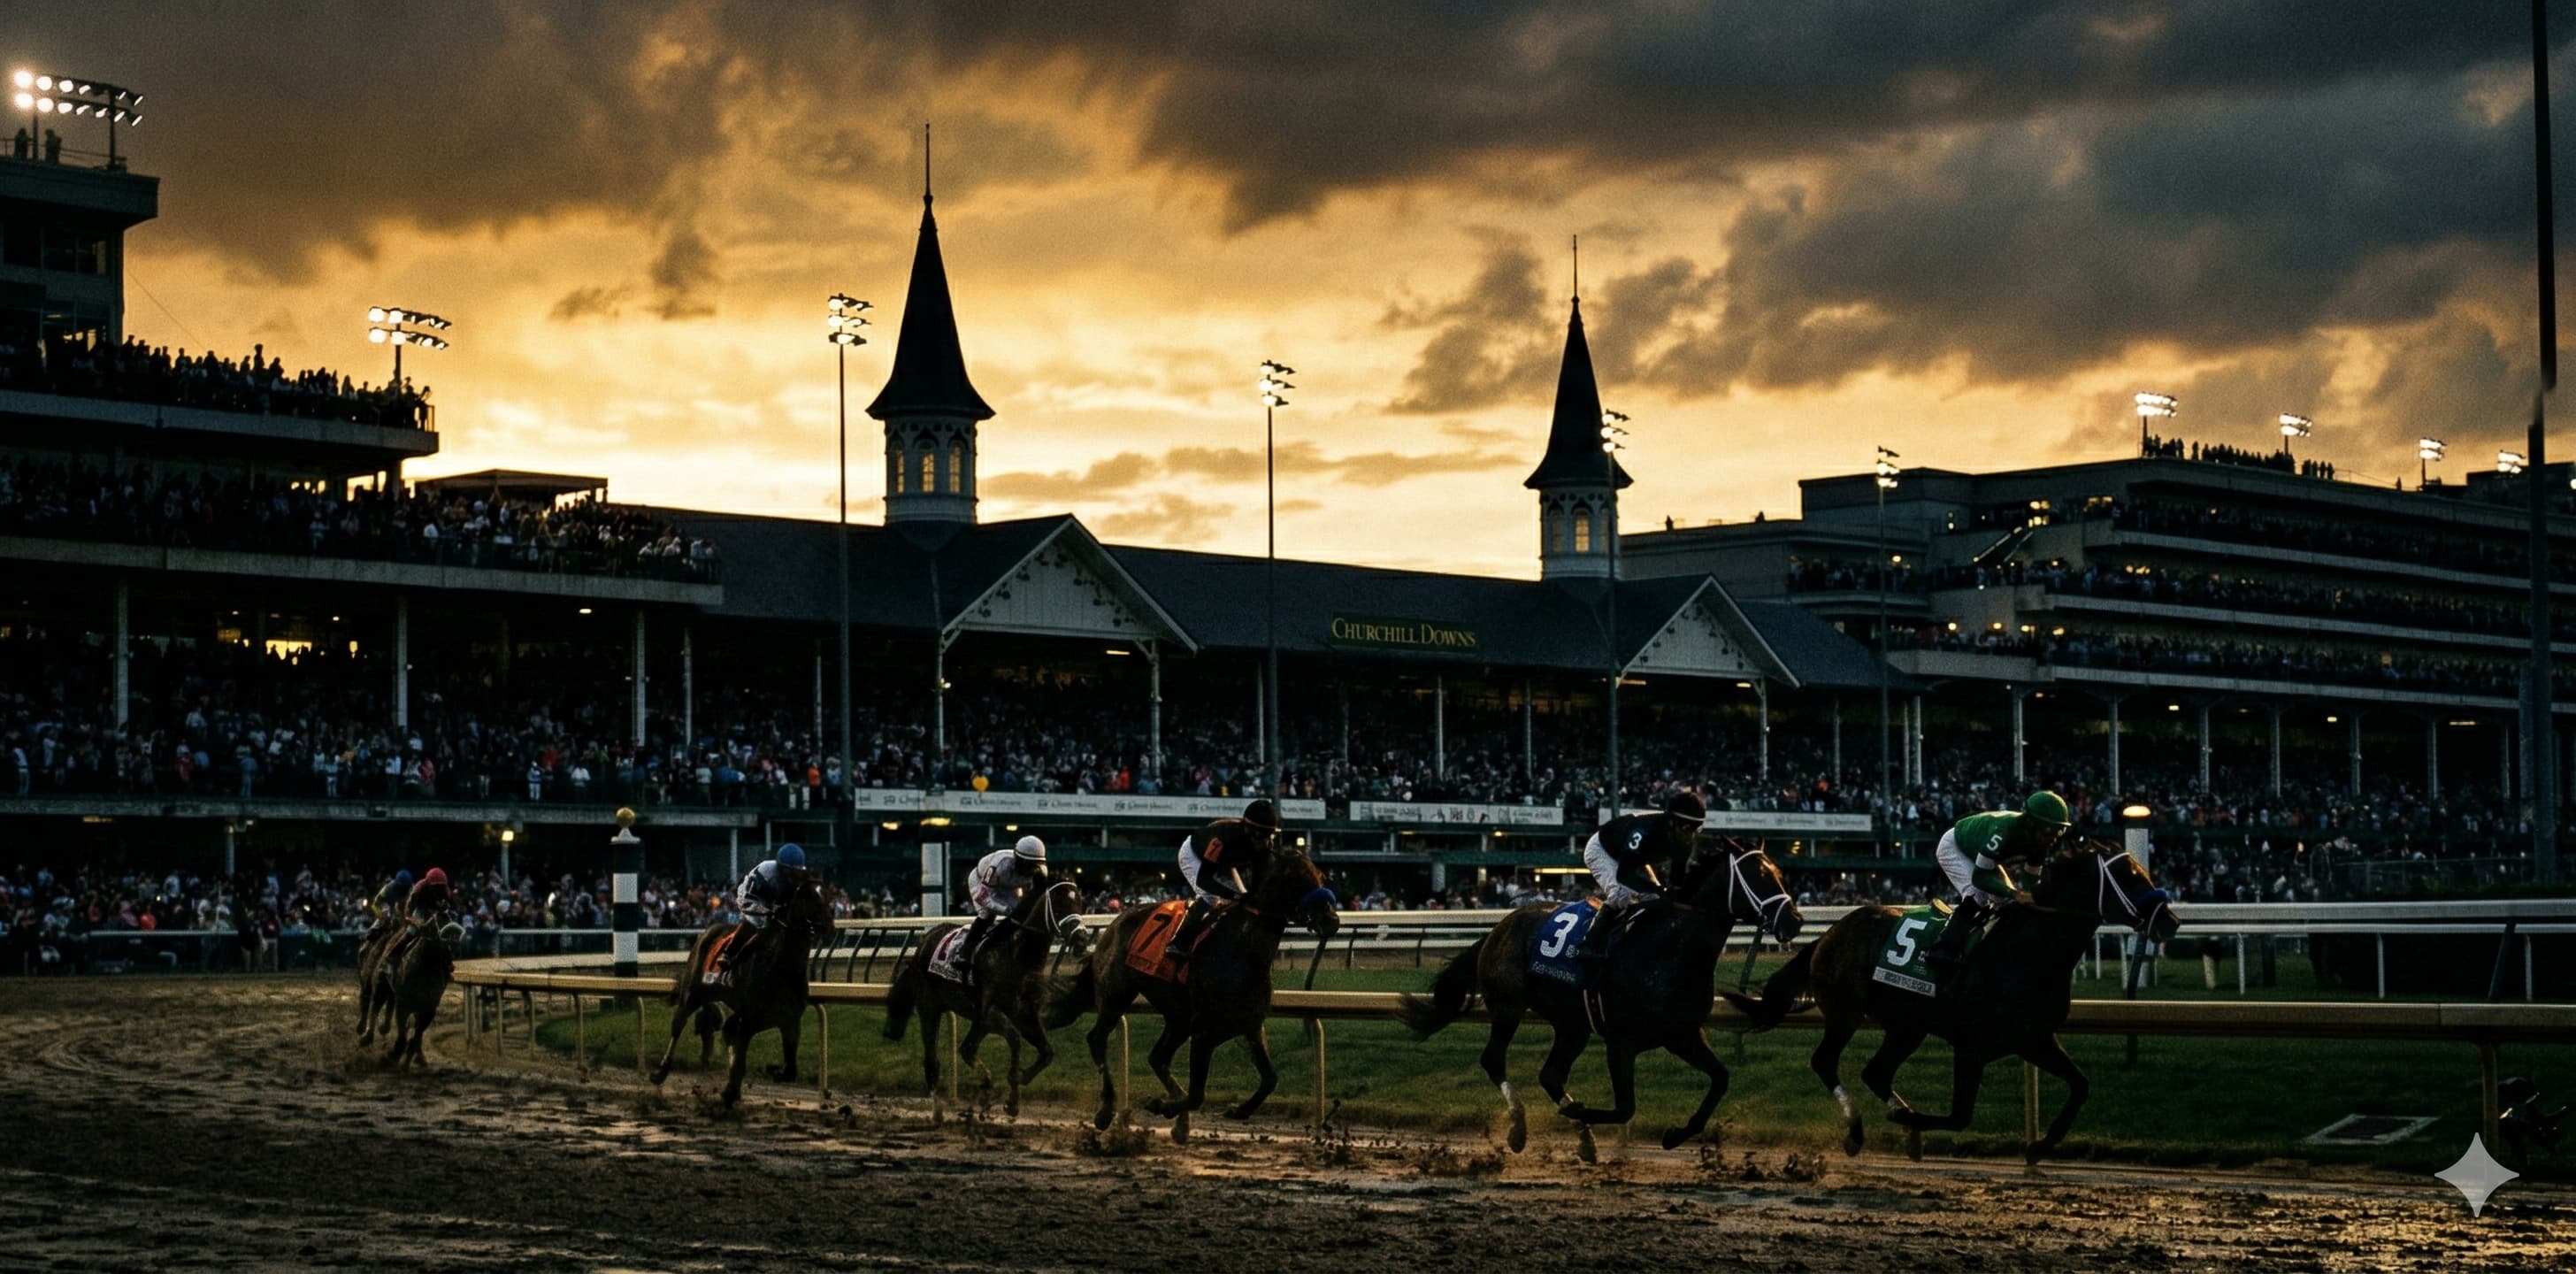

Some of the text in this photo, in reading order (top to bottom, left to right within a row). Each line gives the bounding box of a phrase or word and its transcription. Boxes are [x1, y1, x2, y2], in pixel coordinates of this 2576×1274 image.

[1628, 831, 1643, 850] 3
[1986, 834, 2004, 852] 5
[1138, 913, 1173, 953] 7
[1539, 911, 1579, 958] 3
[1886, 917, 1928, 966] 5
